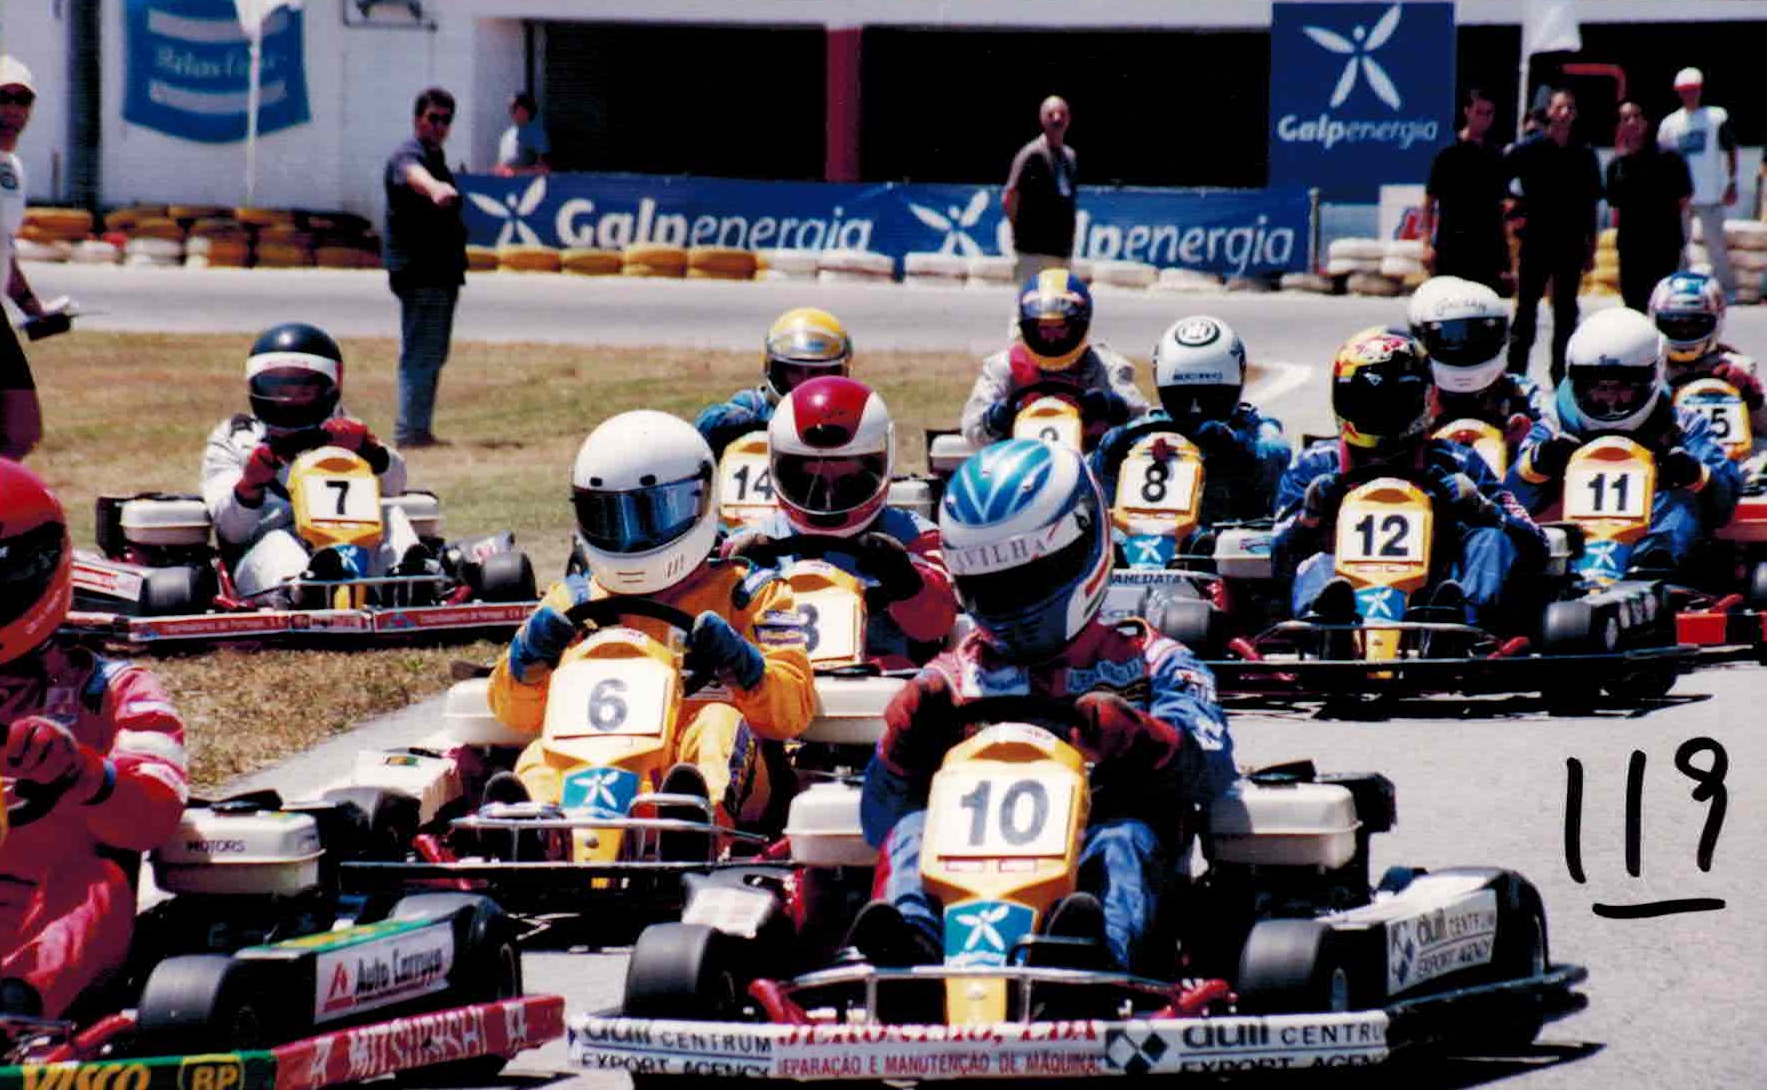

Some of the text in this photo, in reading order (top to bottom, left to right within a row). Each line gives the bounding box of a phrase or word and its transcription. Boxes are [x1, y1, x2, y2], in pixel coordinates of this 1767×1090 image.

[1277, 113, 1439, 150] Galpenergia
[998, 208, 1295, 274] lpenergia
[325, 480, 350, 515] 7
[733, 464, 774, 500] 14
[1141, 462, 1170, 503] 8
[1587, 472, 1629, 511] 11
[1355, 513, 1409, 556] 12
[587, 678, 629, 731] 6
[960, 779, 1049, 846] 10
[1564, 737, 1729, 884] 119
[345, 1004, 490, 1077] MITSUBISHI
[661, 1030, 772, 1052] CENTRUM
[192, 1065, 239, 1090] BP
[870, 1054, 878, 1074] E
